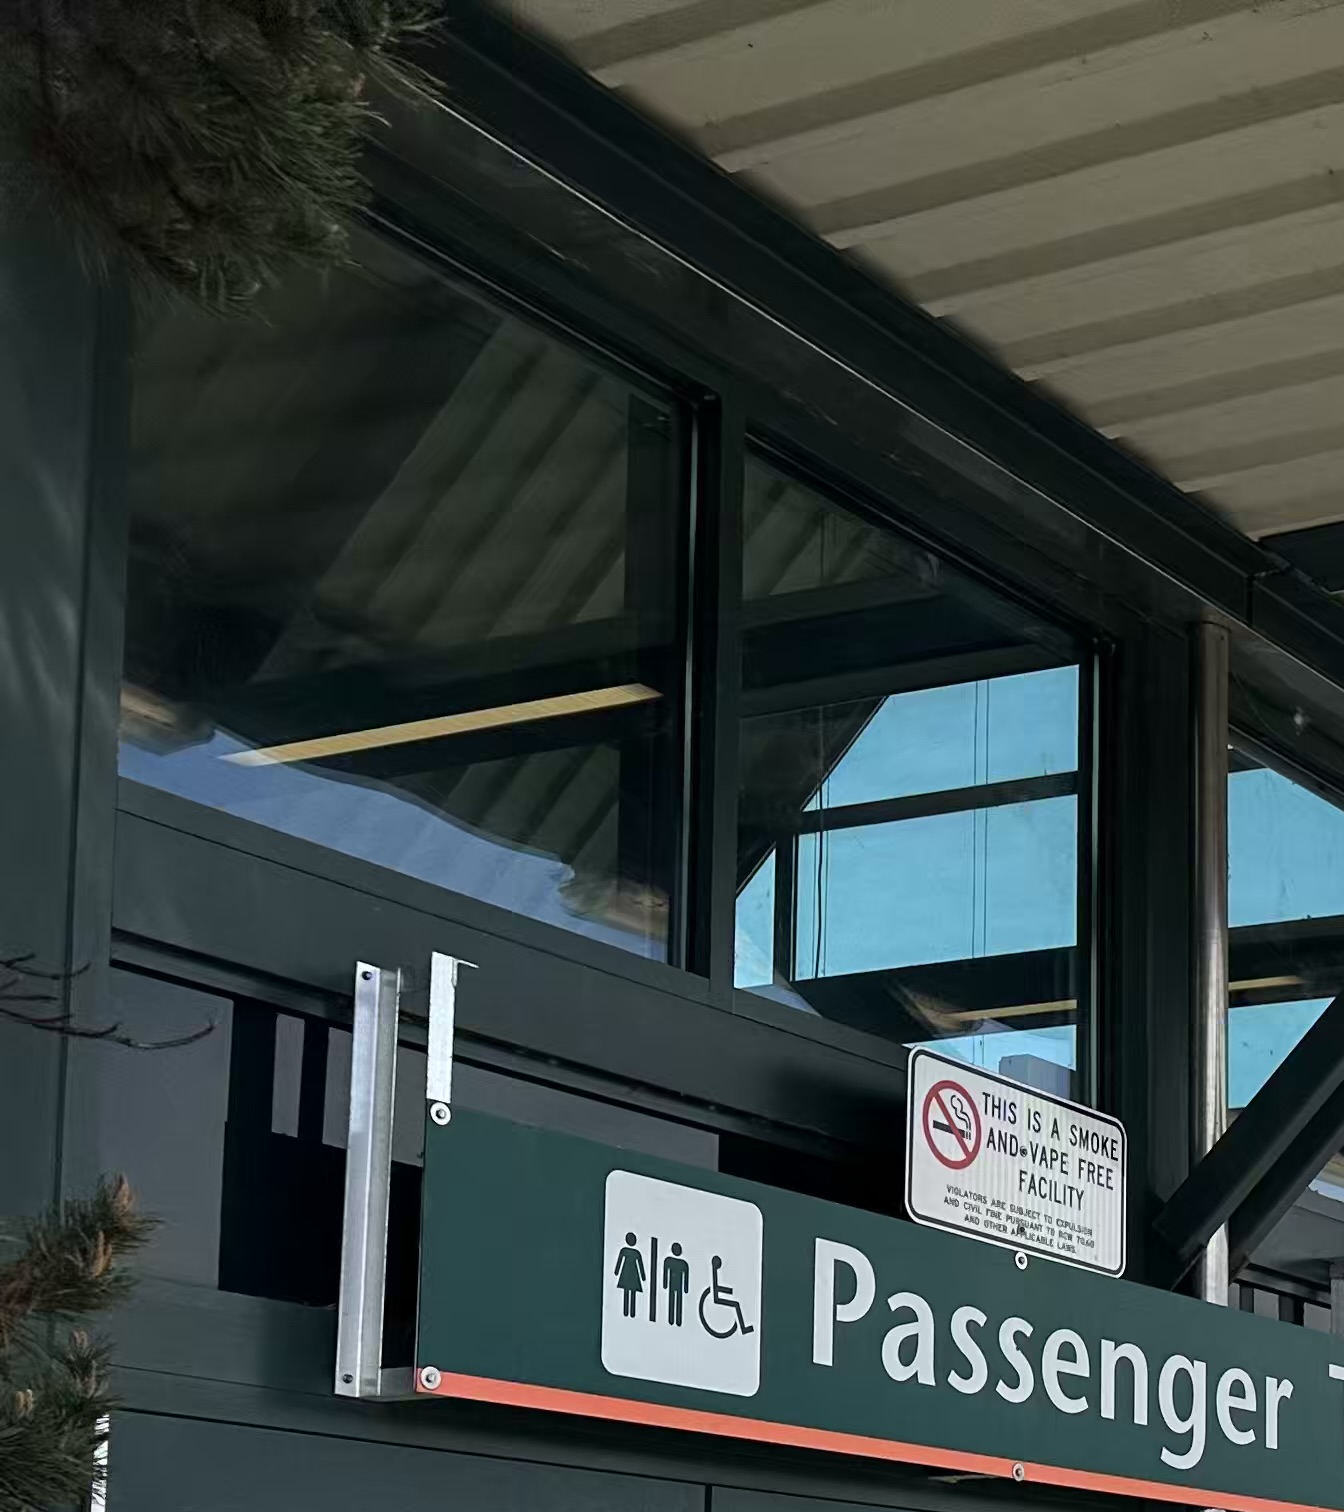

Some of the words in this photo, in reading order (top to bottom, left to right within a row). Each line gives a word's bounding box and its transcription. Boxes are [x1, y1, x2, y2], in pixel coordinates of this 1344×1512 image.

[982, 1092, 1017, 1124] THIS
[1028, 1108, 1042, 1133] IS
[1051, 1118, 1060, 1140] A
[1069, 1124, 1118, 1161] SMOKE
[987, 1128, 1018, 1157] AND
[1030, 1141, 1068, 1175] VAPE
[1078, 1158, 1114, 1190] FREE
[944, 1196, 960, 1208] AND
[947, 1184, 987, 1205] VIOLATORS
[1019, 1170, 1084, 1211] FACILITY
[964, 1214, 980, 1226] AND
[984, 1219, 1008, 1233] OTHER
[812, 1237, 1294, 1470] Passenger
